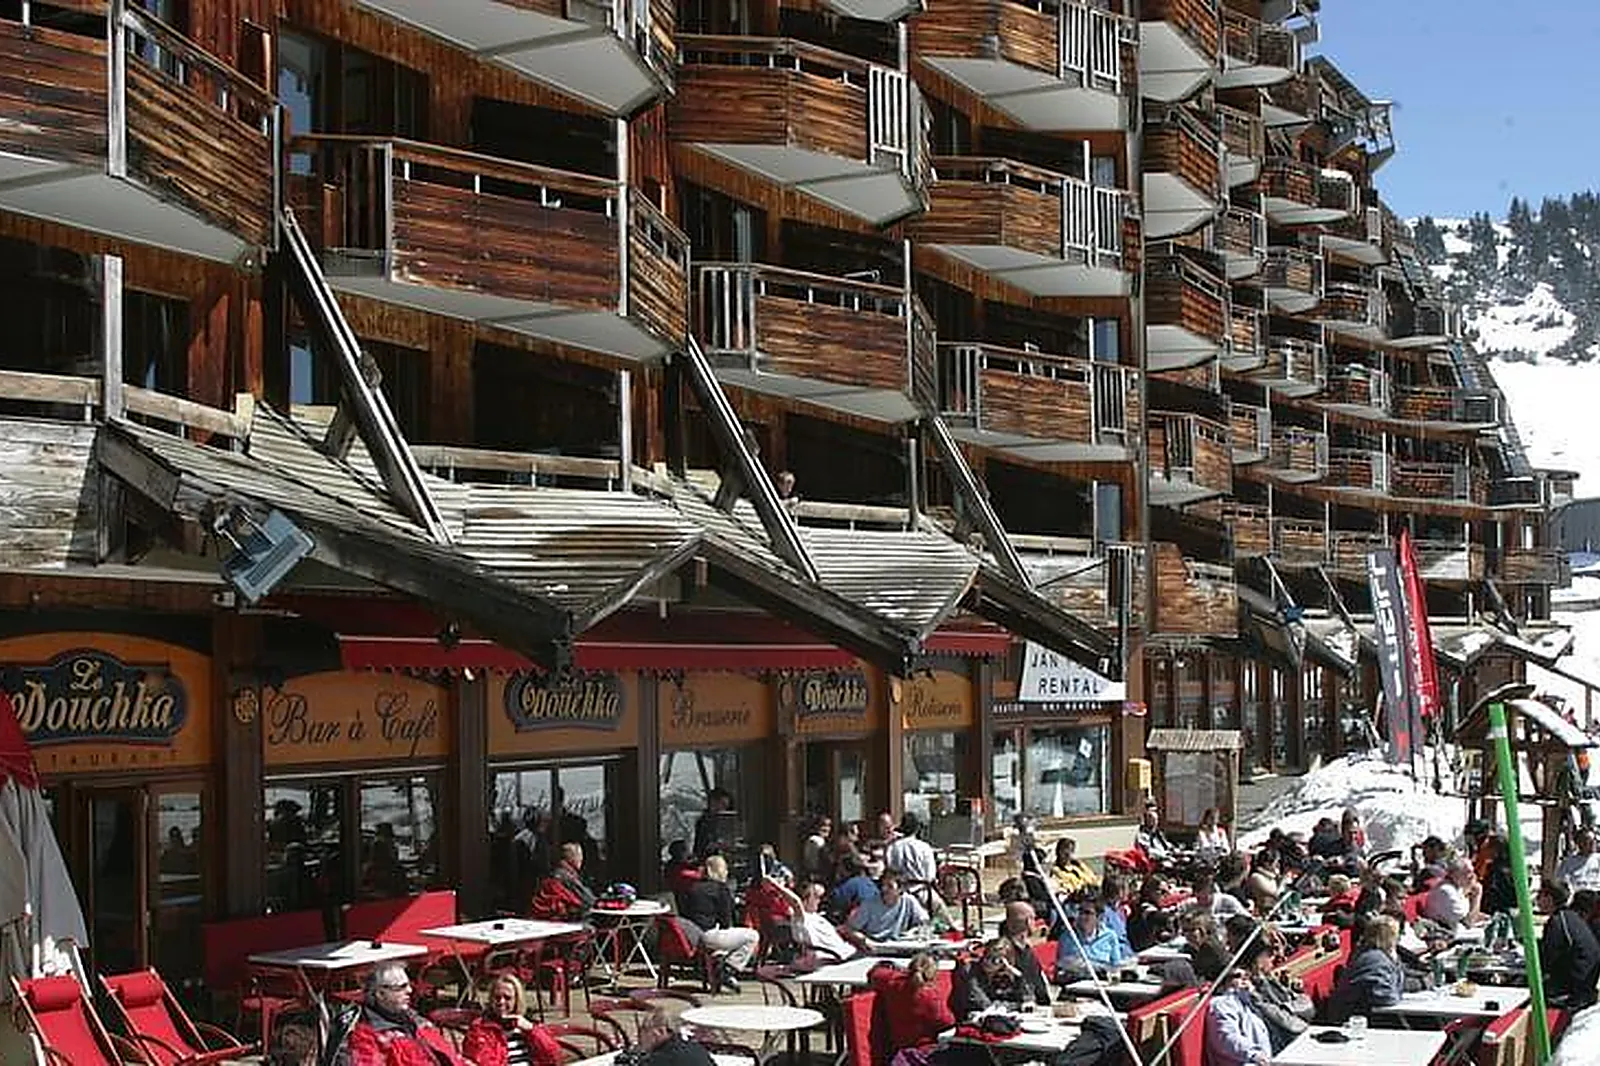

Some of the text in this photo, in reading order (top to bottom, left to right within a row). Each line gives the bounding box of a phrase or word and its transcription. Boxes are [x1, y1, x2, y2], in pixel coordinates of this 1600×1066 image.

[12, 679, 175, 733] Douchka
[1038, 677, 1100, 694] RENTAL
[268, 691, 341, 745] Bar
[374, 690, 438, 757] Café
